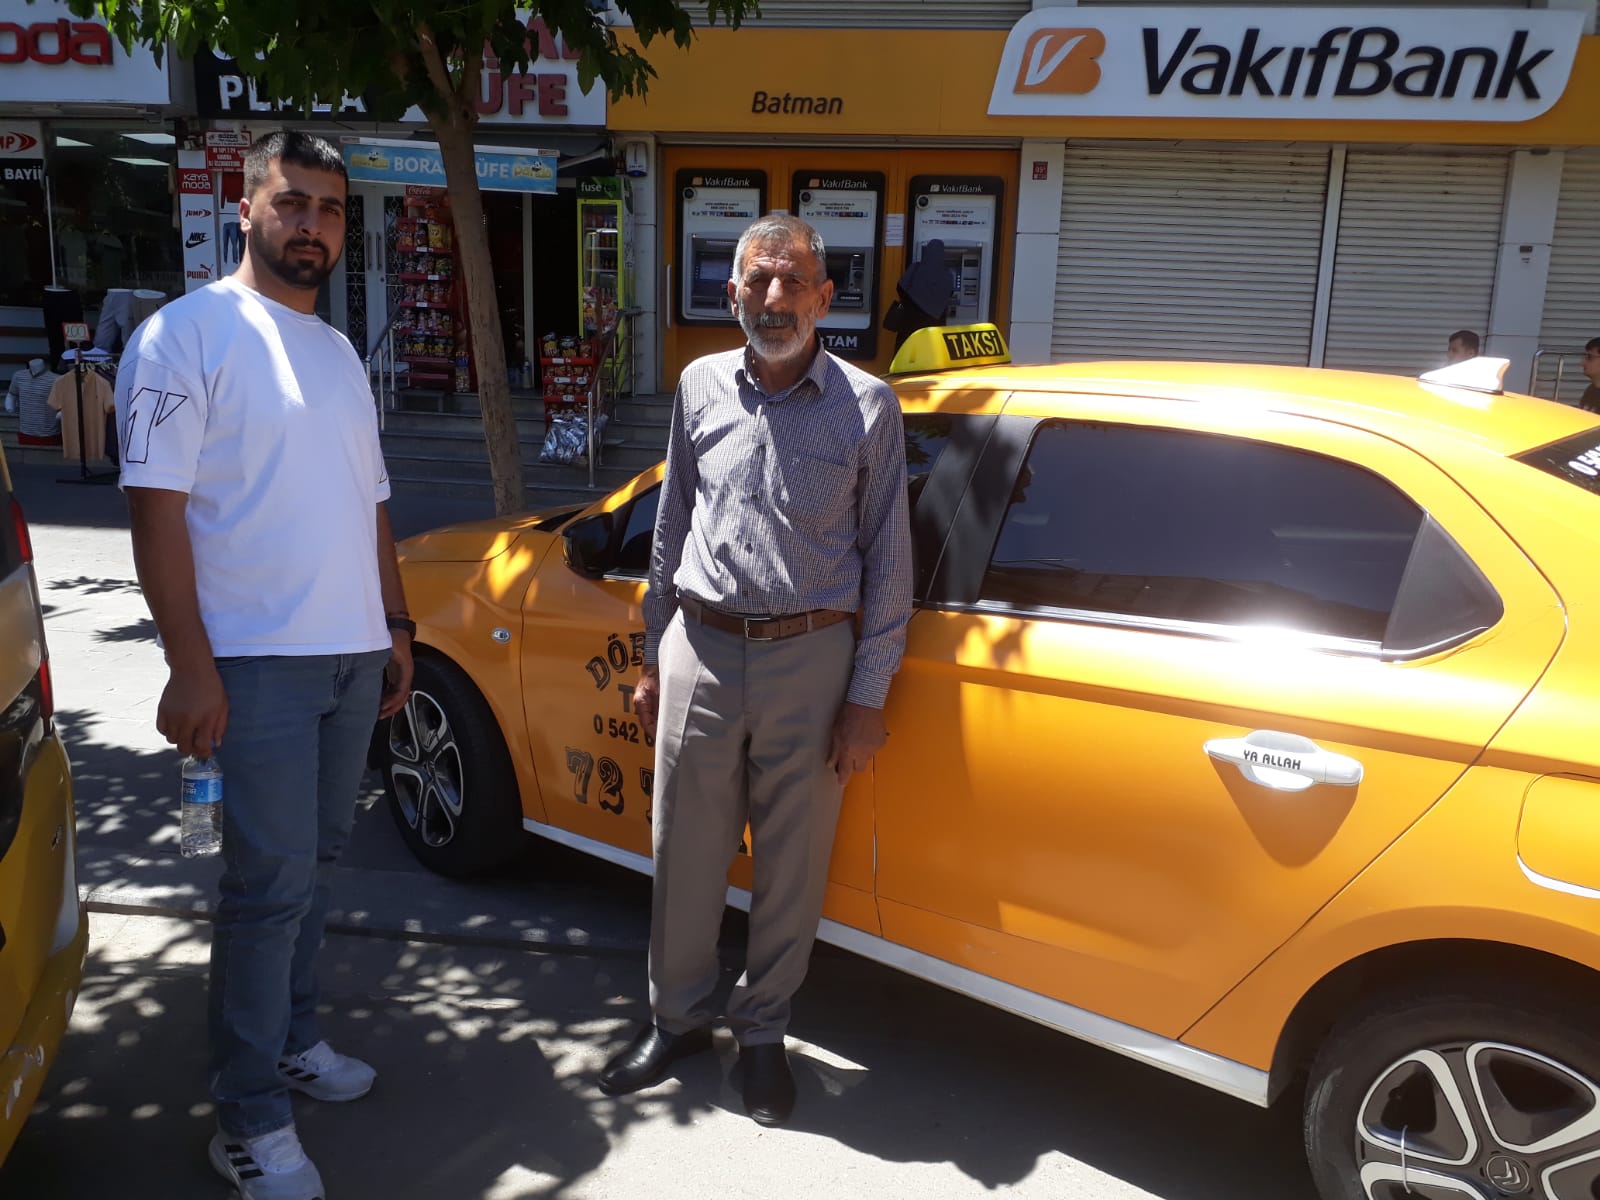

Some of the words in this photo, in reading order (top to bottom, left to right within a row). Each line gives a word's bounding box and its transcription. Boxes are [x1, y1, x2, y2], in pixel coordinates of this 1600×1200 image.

[1141, 27, 1554, 101] VakıfBank
[751, 90, 843, 115] Batman
[394, 156, 446, 175] BORA
[476, 157, 509, 178] ÜFE
[580, 181, 602, 194] fuse
[189, 231, 207, 241] NIKE
[186, 270, 209, 279] PUMA
[826, 335, 858, 348] TAM
[608, 717, 640, 744] 542
[1243, 749, 1258, 762] YA
[1262, 753, 1301, 770] ALLAH
